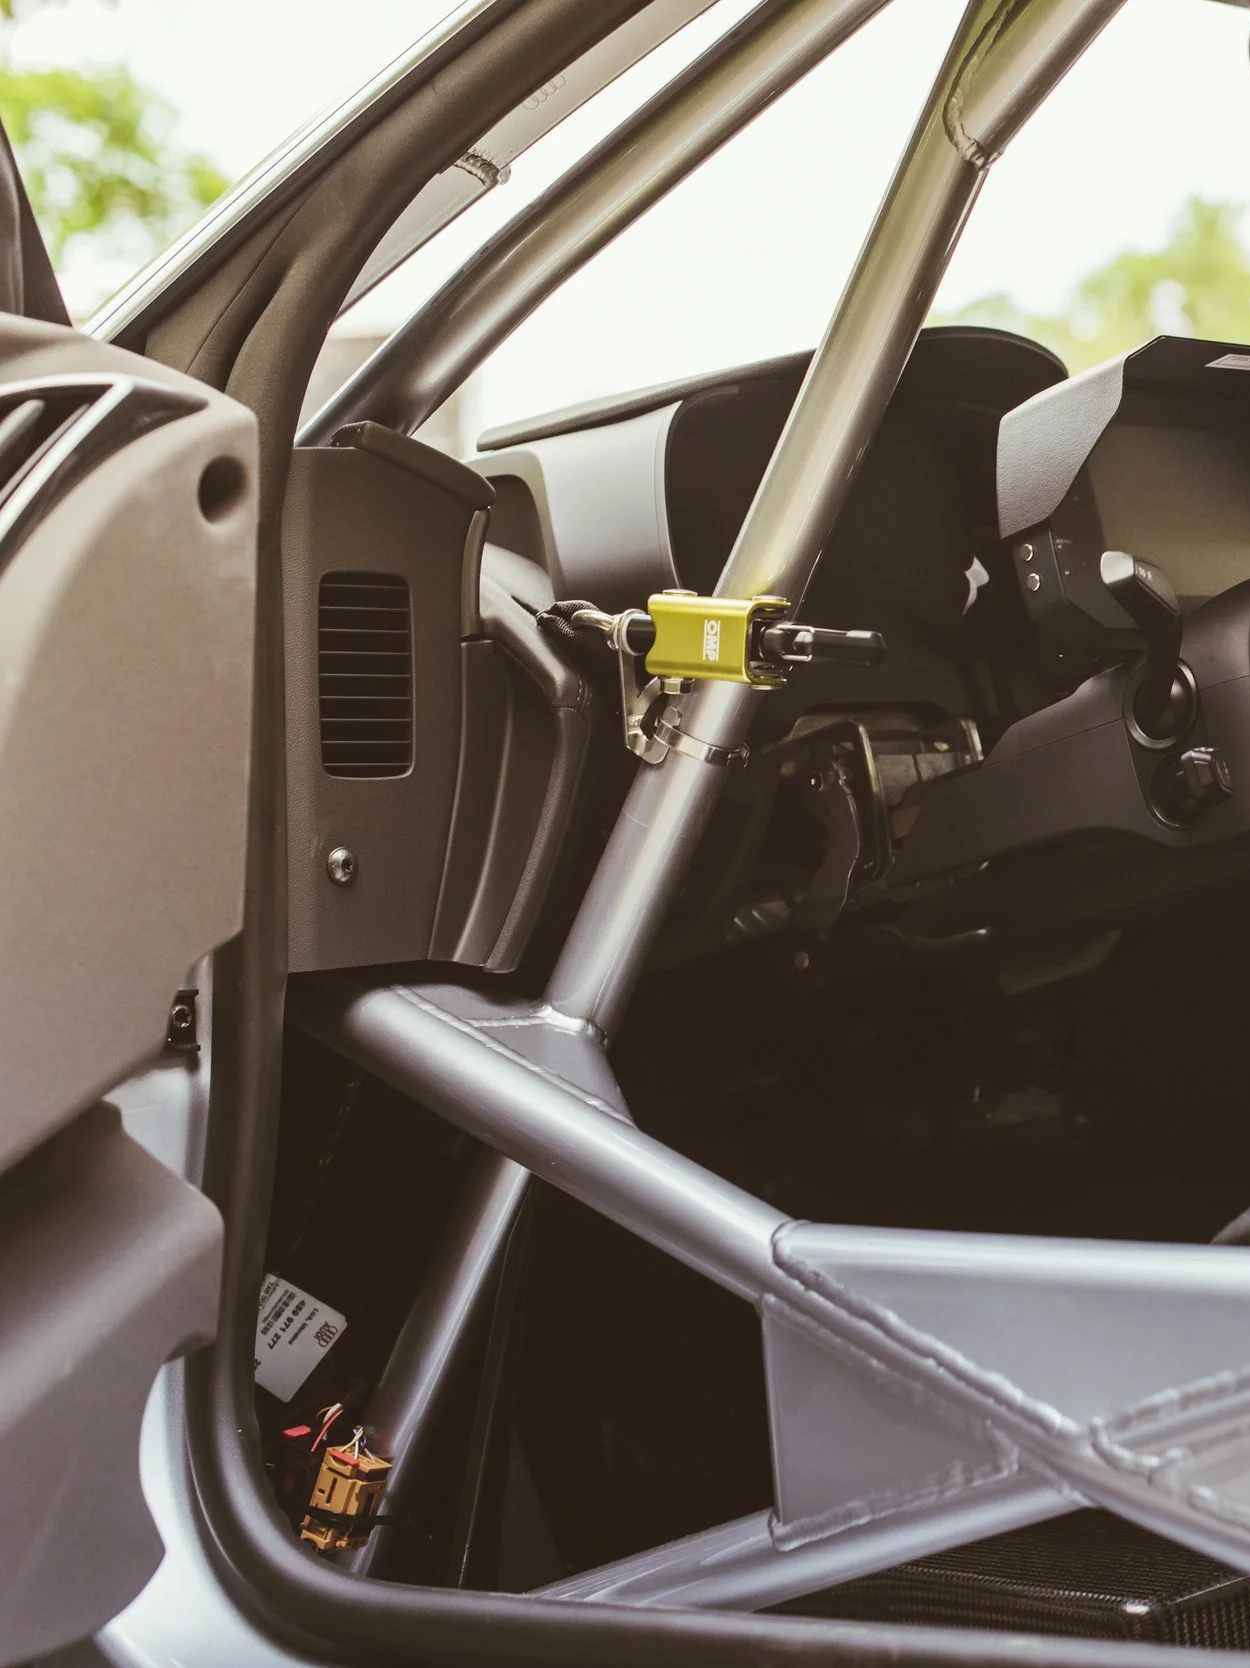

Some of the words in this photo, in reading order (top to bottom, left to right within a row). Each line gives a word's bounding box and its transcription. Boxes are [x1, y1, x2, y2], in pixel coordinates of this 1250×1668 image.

[703, 619, 720, 662] OMP
[314, 1321, 330, 1341] AUDI
[267, 1334, 282, 1350] 277
